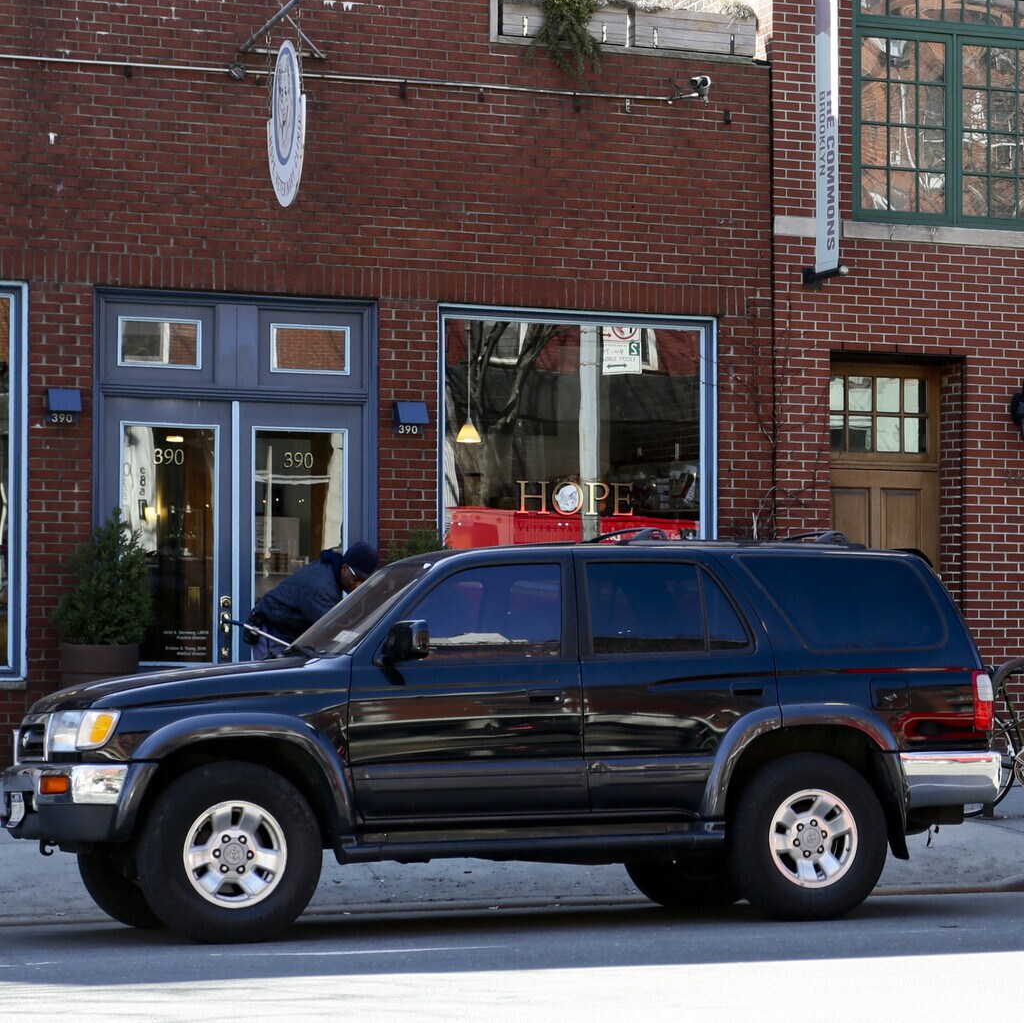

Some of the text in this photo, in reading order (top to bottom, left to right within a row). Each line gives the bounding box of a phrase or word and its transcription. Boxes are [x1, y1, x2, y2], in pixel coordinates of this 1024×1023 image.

[818, 91, 826, 177] BROOKLYN
[826, 135, 835, 251] COMMONS
[51, 412, 73, 424] 390
[398, 424, 418, 435] 390
[153, 448, 186, 466] 390
[283, 452, 315, 469] 390
[516, 480, 634, 516] HOPE
